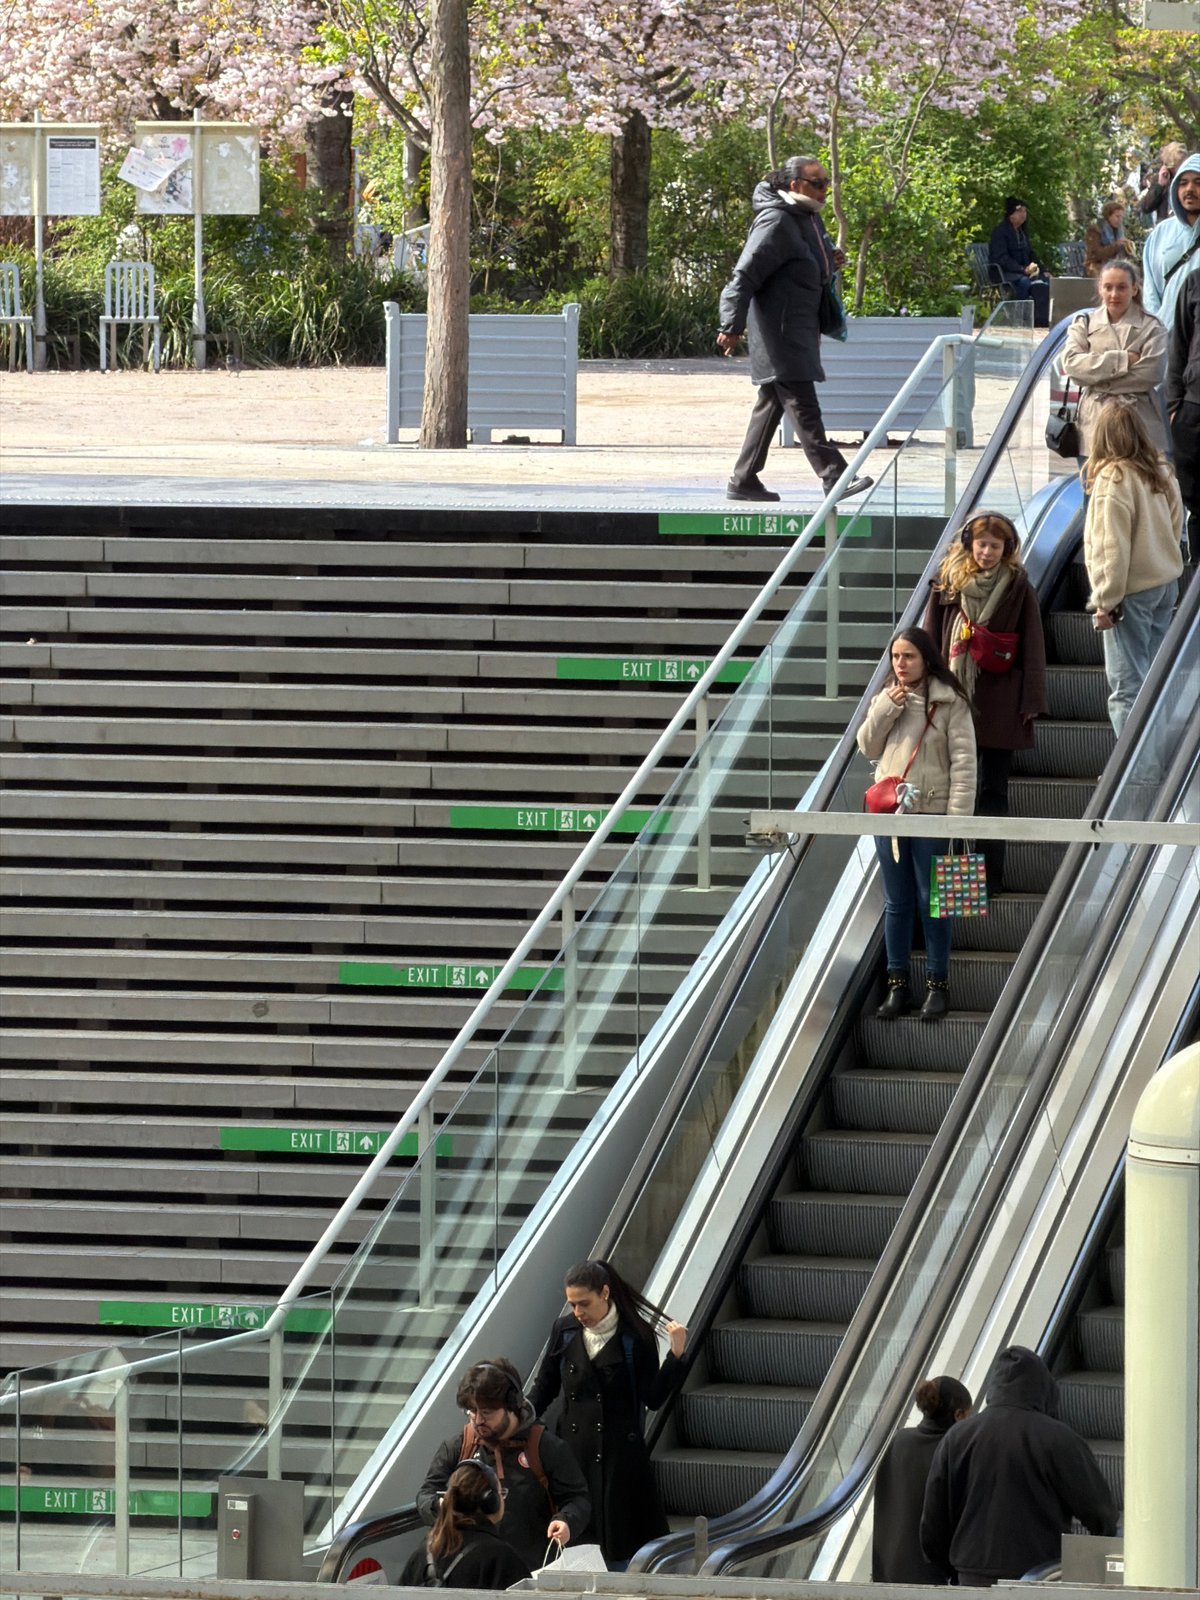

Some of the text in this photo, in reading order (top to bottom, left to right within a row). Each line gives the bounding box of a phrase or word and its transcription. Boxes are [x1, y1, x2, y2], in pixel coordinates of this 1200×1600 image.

[723, 516, 753, 532] EXIT
[622, 662, 652, 677] EXIT
[517, 811, 548, 826] EXIT
[408, 967, 439, 983] EXIT
[291, 1132, 323, 1149] EXIT
[172, 1306, 204, 1323] EXIT
[44, 1491, 78, 1508] EXIT
